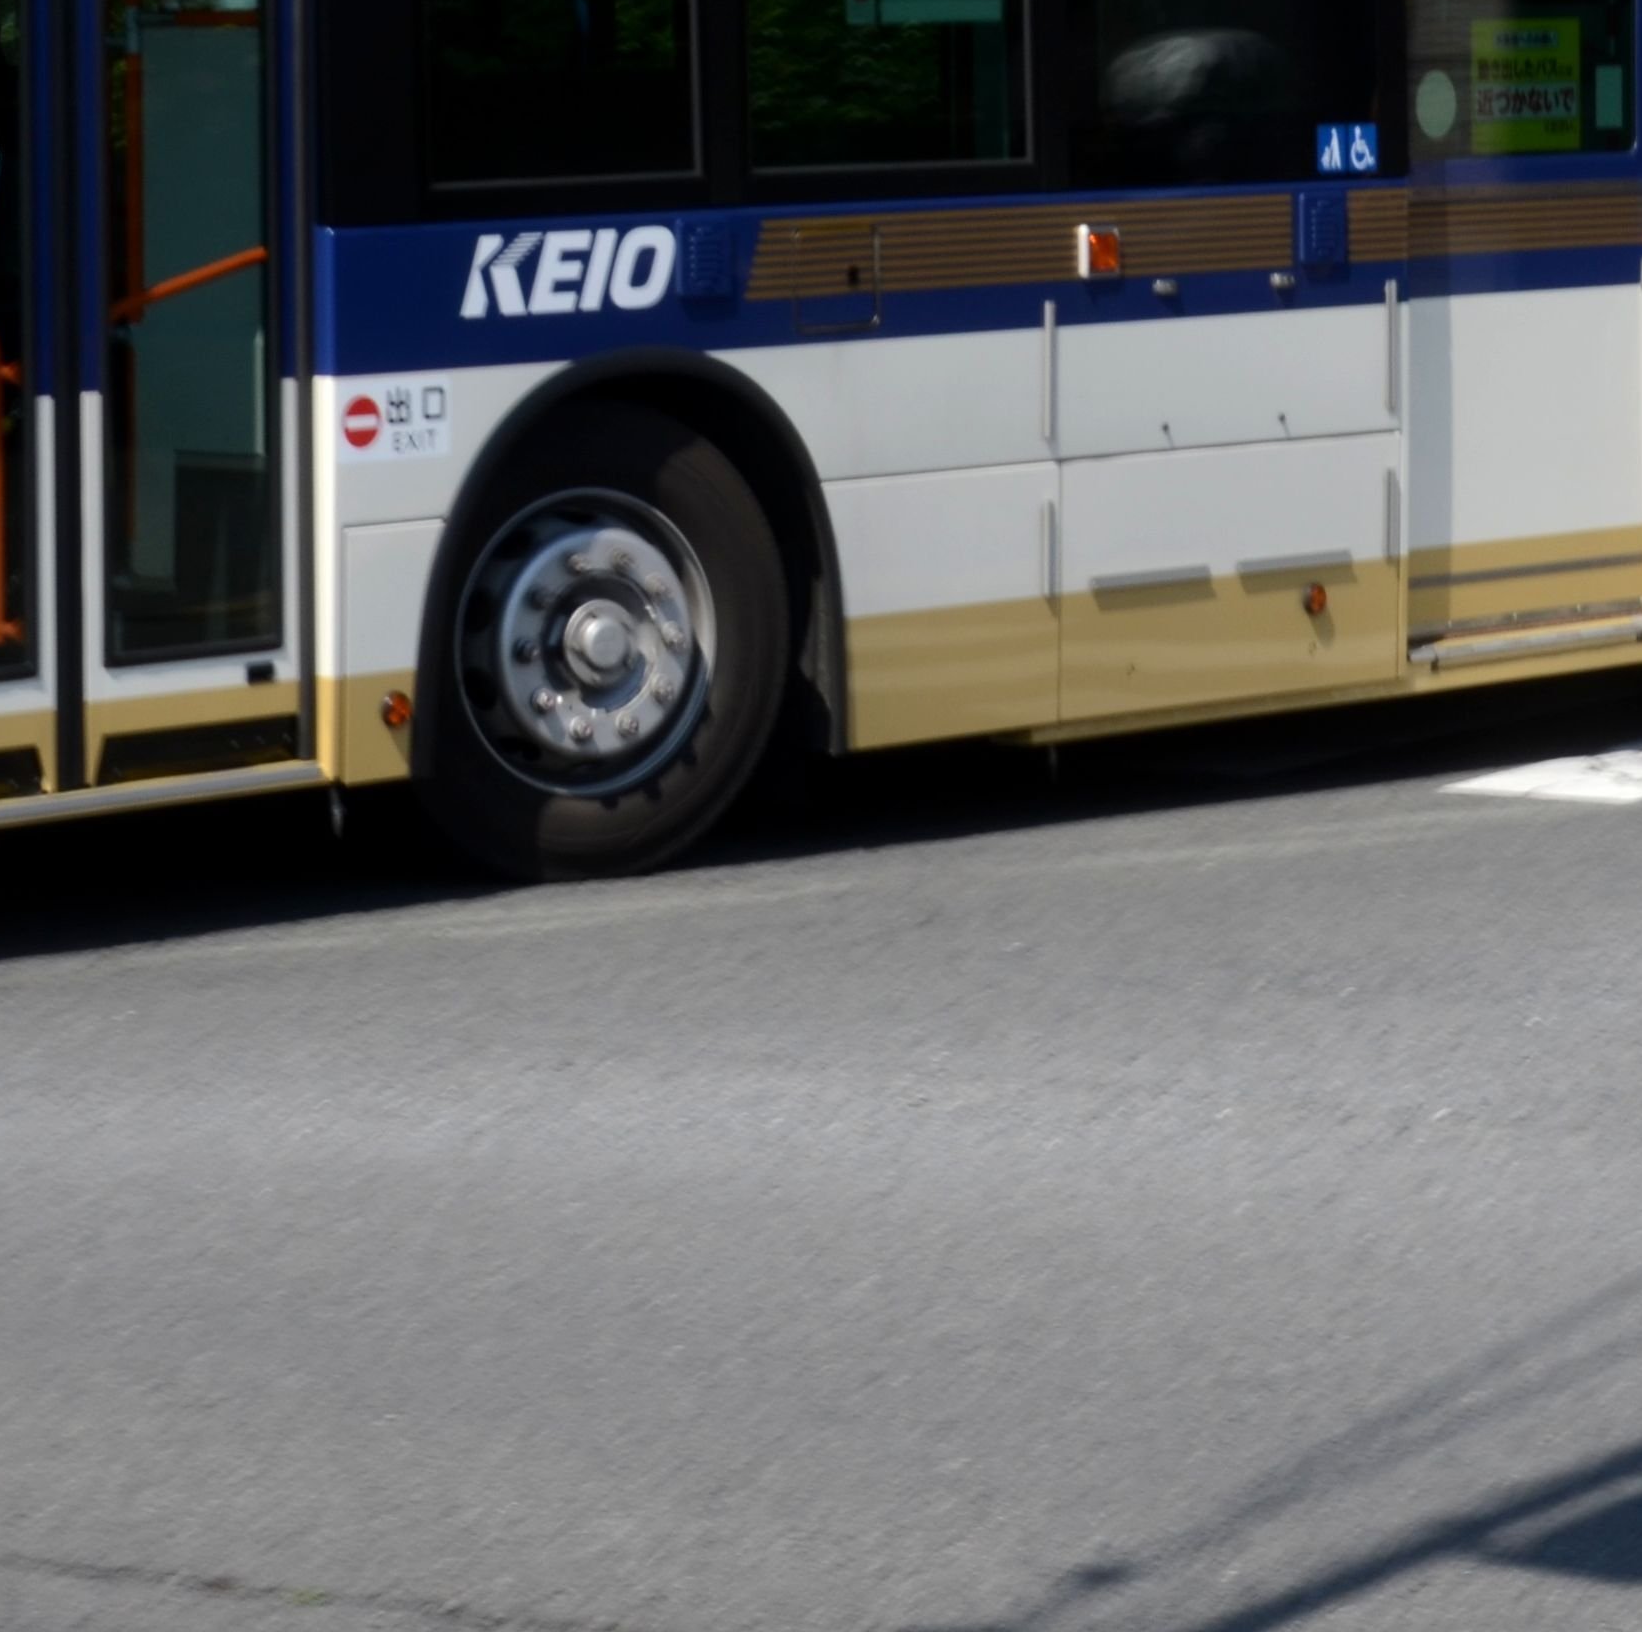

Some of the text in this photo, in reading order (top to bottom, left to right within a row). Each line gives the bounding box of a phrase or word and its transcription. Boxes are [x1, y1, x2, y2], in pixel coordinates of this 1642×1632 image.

[460, 223, 677, 320] KEIO
[386, 386, 446, 426] 出口
[391, 428, 437, 454] EXIT
